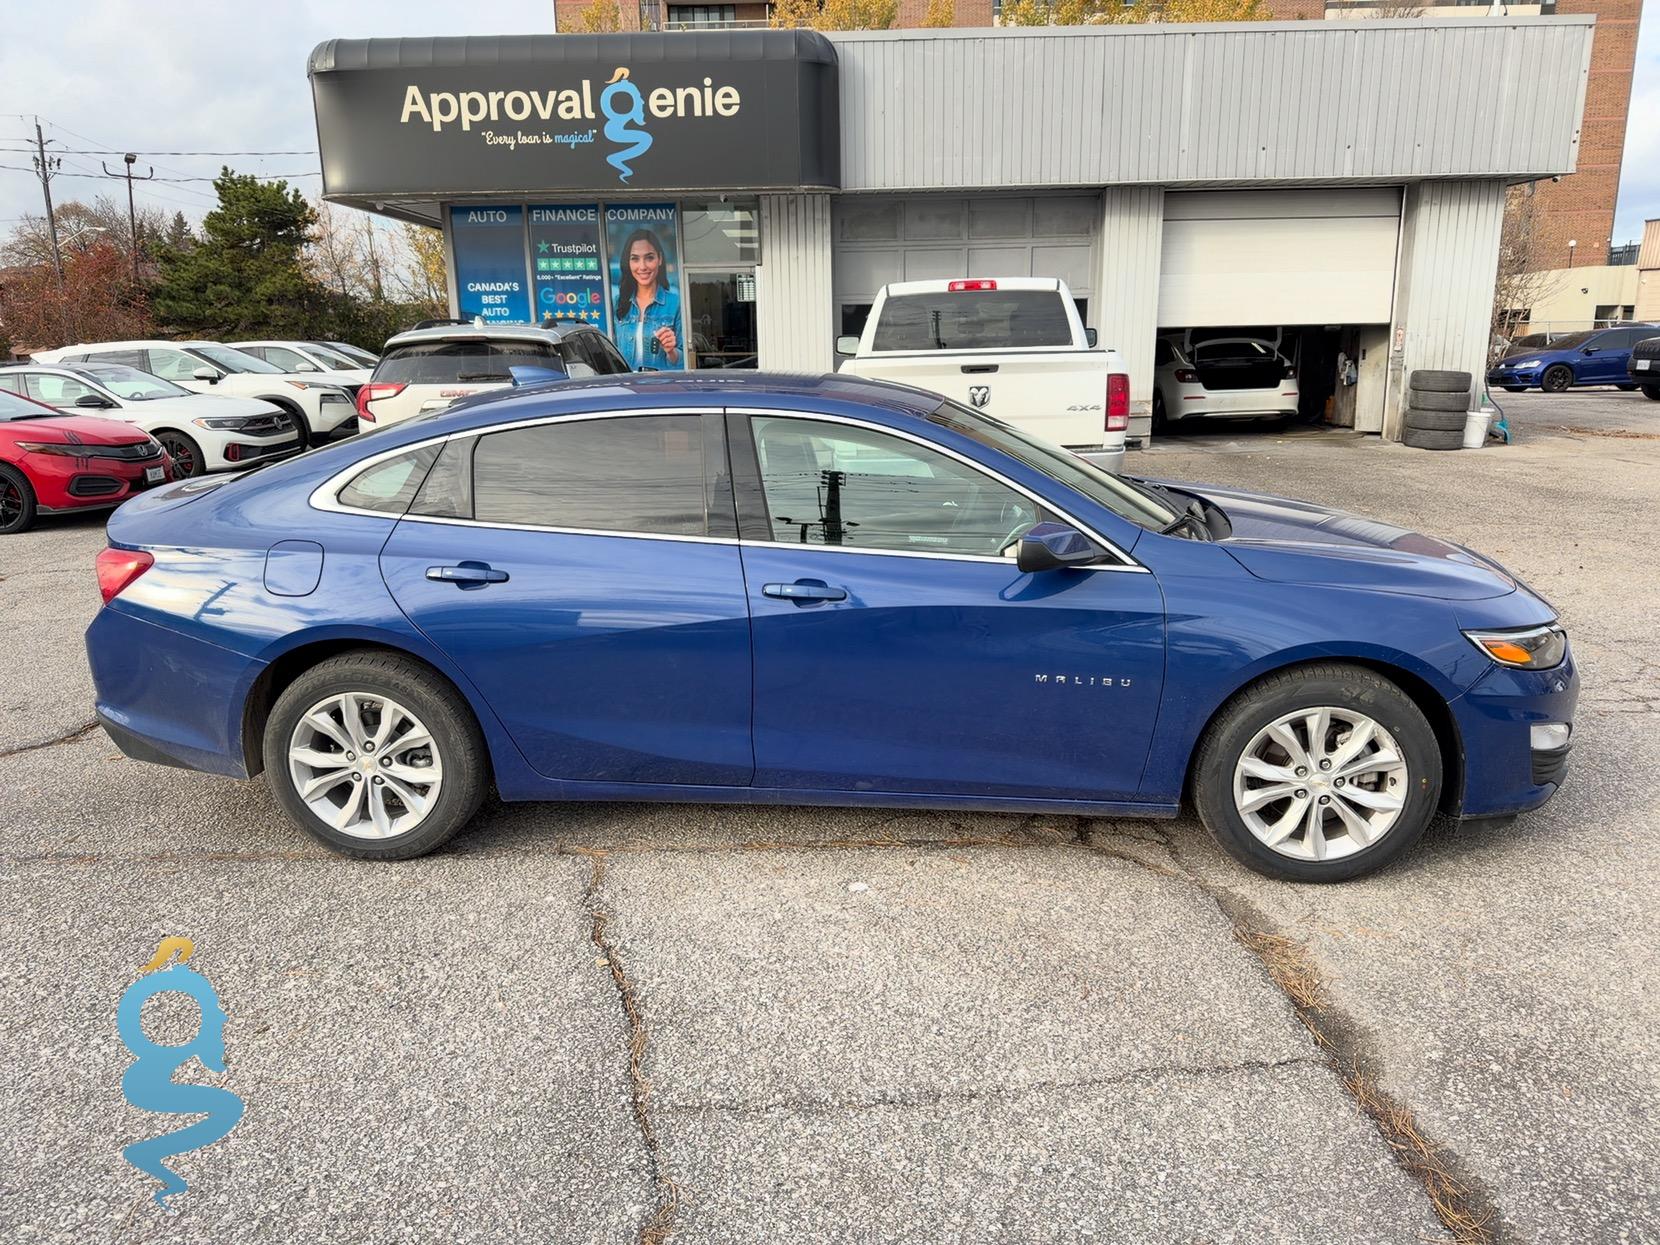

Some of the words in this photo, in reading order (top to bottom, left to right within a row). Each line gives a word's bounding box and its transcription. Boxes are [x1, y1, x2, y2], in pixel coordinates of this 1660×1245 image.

[400, 79, 595, 132] Approval
[517, 130, 541, 144] loan
[542, 131, 553, 143] is
[468, 211, 507, 223] AUTO
[533, 208, 597, 222] FINANCE
[607, 208, 674, 221] COMPANY
[551, 243, 596, 254] Trustpilot
[467, 282, 520, 292] CANADA'S
[481, 295, 507, 304] BEST
[540, 287, 600, 308] Google
[481, 307, 510, 317] AUTO
[1035, 674, 1131, 687] MALIBU
